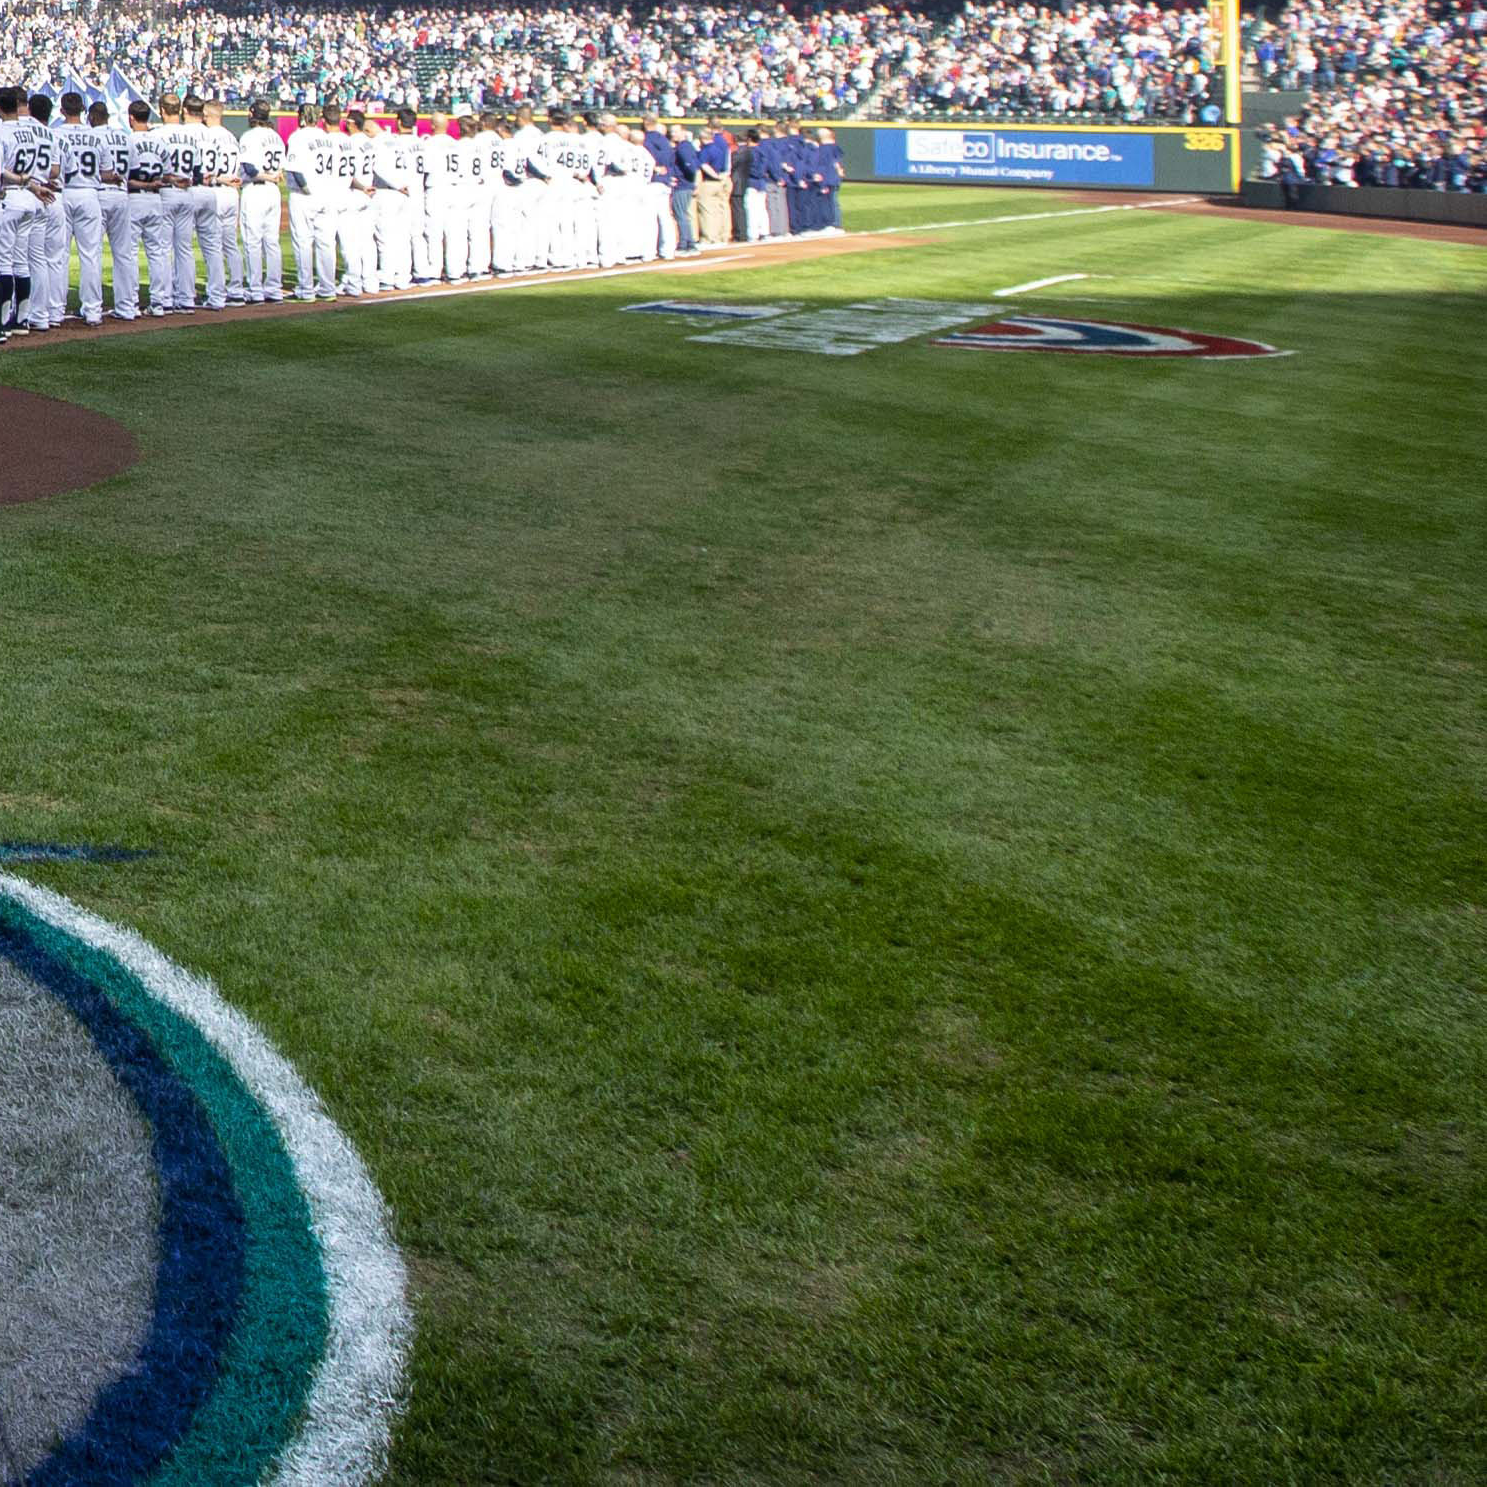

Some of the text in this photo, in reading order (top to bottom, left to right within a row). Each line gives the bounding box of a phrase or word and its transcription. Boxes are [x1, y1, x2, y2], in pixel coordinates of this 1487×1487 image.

[170, 148, 194, 173] 49
[556, 151, 575, 169] 48
[997, 138, 1111, 162] Insurance
[263, 151, 282, 172] 35
[315, 153, 333, 176] 34
[339, 156, 356, 178] 25
[446, 153, 459, 173] 15
[919, 165, 957, 179] Liberty
[960, 165, 998, 178] Mutual
[998, 166, 1055, 180] Company
